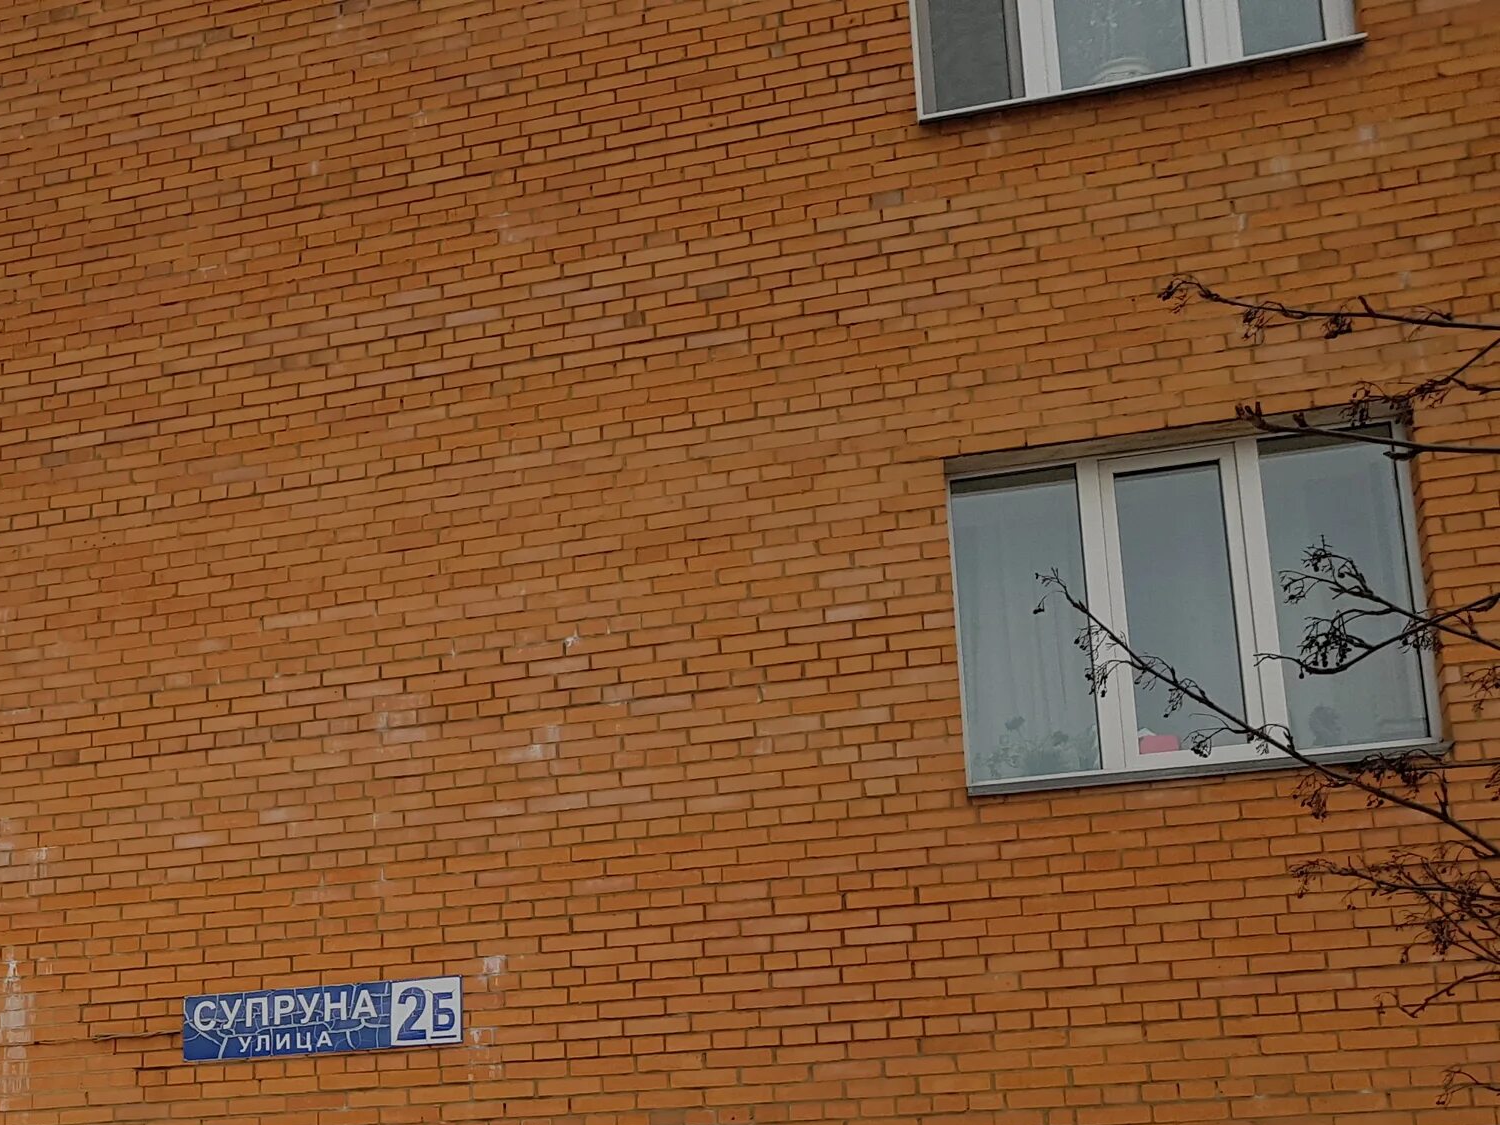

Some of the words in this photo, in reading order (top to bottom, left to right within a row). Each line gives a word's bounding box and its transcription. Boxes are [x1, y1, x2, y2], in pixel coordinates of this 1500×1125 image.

[193, 990, 379, 1031] СУПРУНА
[396, 986, 457, 1041] 2Б
[238, 1030, 333, 1053] УЛИЦА
